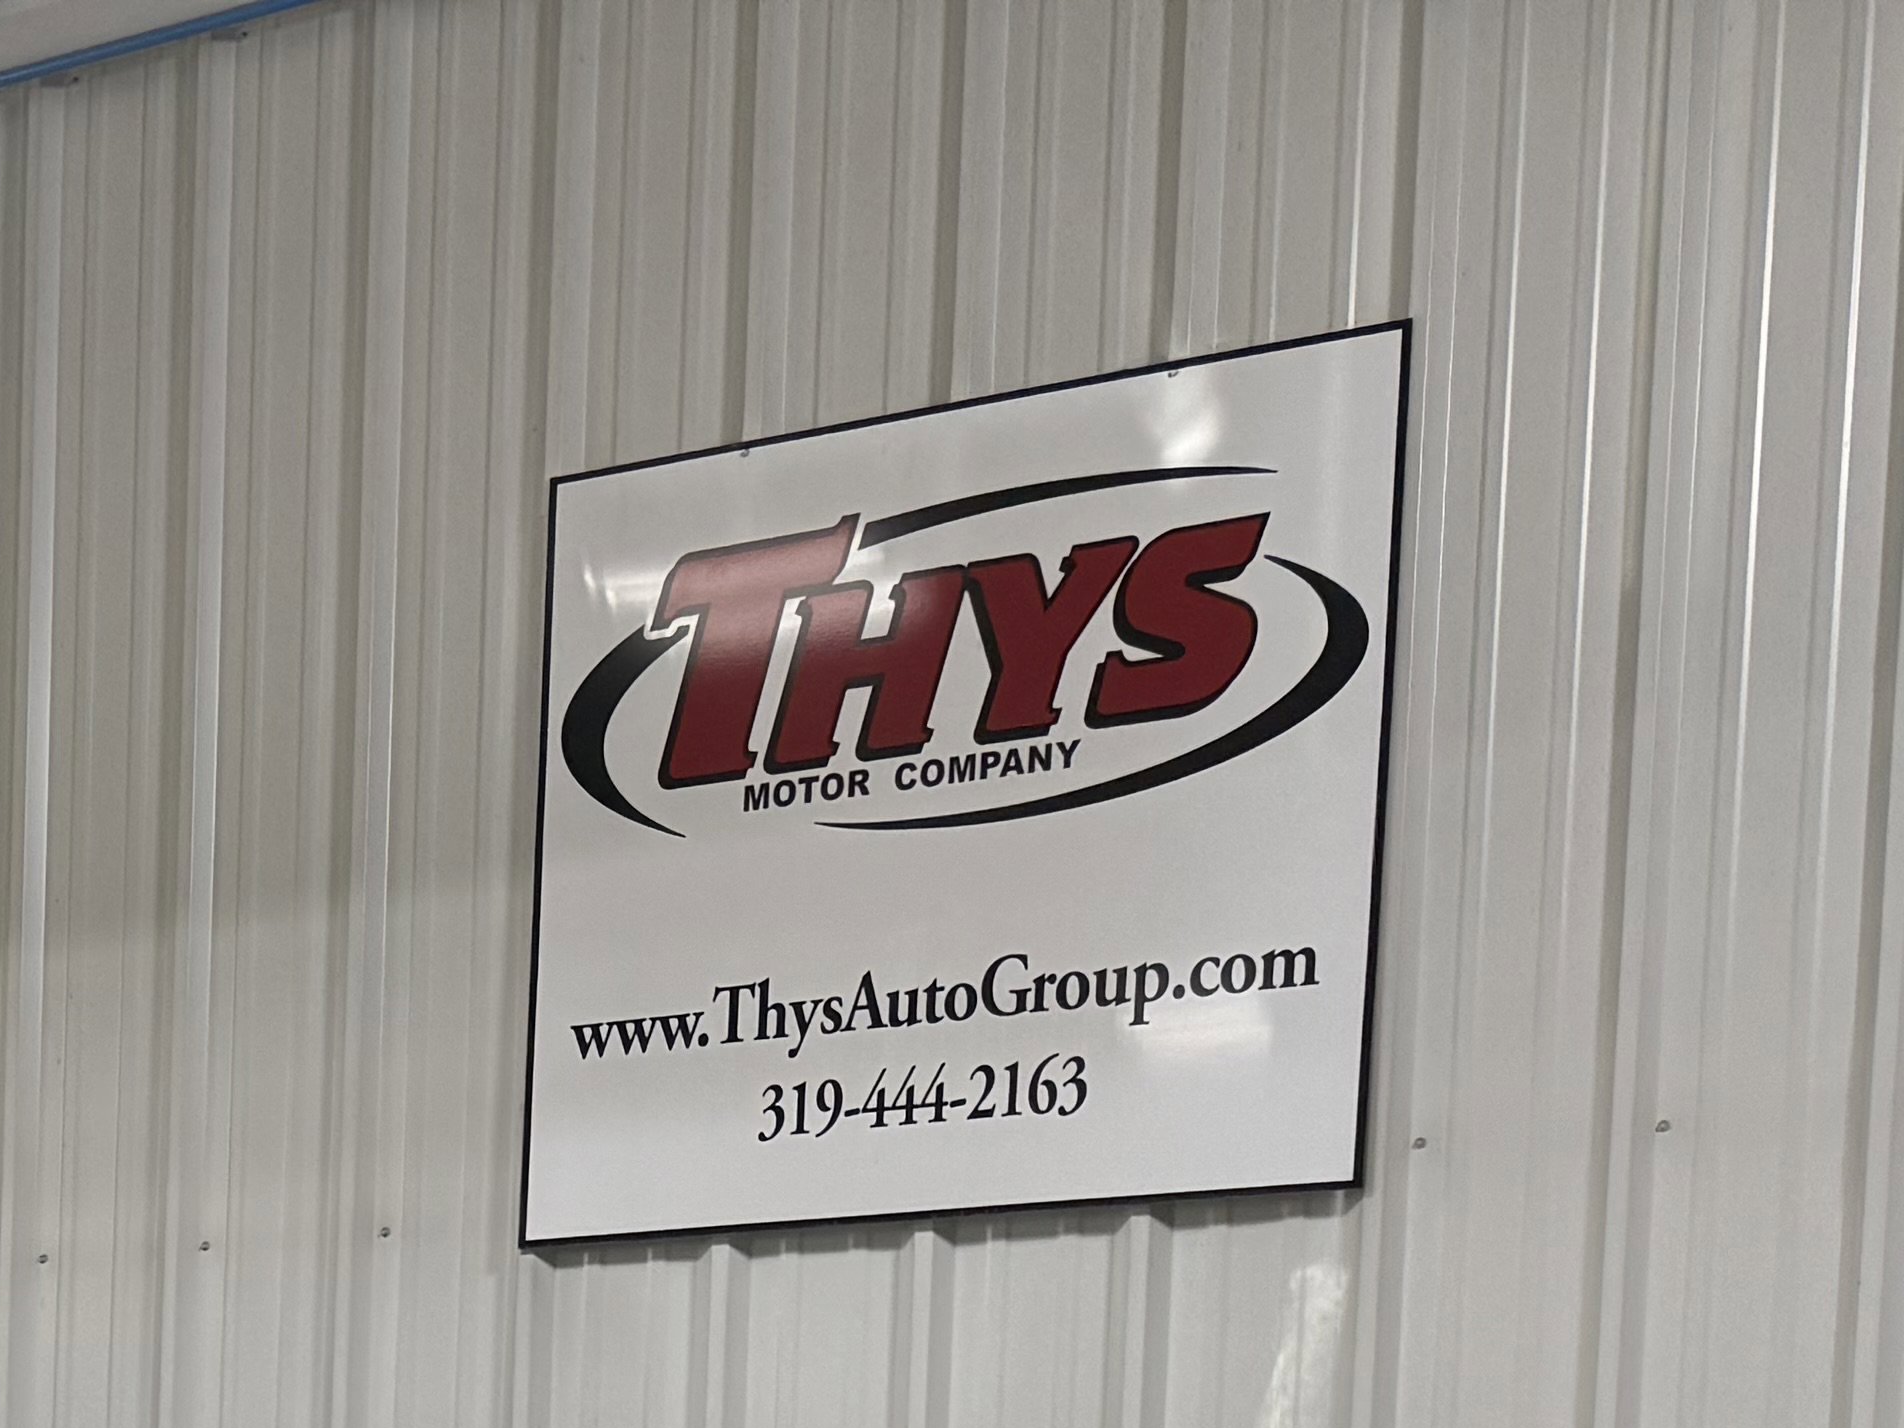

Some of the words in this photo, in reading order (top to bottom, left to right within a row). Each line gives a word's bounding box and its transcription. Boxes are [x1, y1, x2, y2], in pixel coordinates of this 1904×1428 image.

[649, 511, 1271, 790] THYS
[742, 768, 870, 813] MOTOR
[895, 739, 1082, 794] COMPANY
[571, 945, 1320, 1060] www.ThysAutoGroup.com
[758, 1054, 1089, 1142] 319-444-2163
